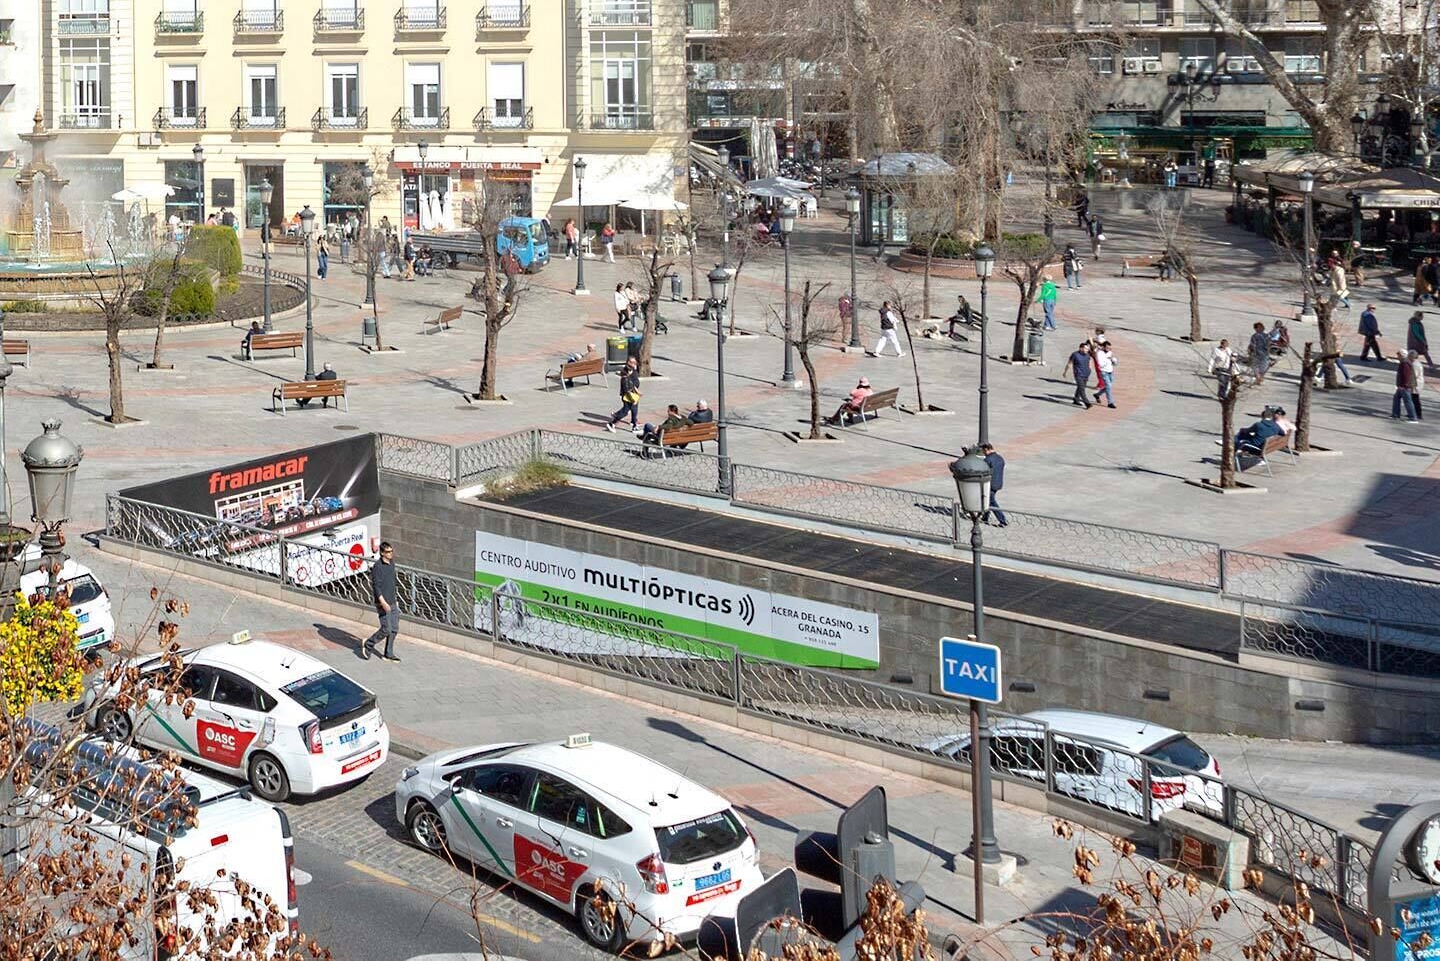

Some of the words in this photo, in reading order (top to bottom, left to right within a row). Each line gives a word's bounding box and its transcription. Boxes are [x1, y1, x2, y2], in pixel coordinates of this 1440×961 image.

[209, 455, 308, 495] framacar
[330, 536, 351, 548] Puerta
[351, 531, 364, 543] Real
[480, 550, 522, 569] CENTRO
[524, 559, 577, 580] AUDITIVO
[593, 604, 665, 629] AUDÍFONOS
[771, 606, 799, 619] ACERA
[801, 612, 817, 623] DEL
[858, 625, 869, 634] 15
[798, 623, 842, 640] GRANADA
[944, 657, 996, 684] TAXI
[215, 732, 236, 746] ASC
[542, 857, 566, 876] ASC
